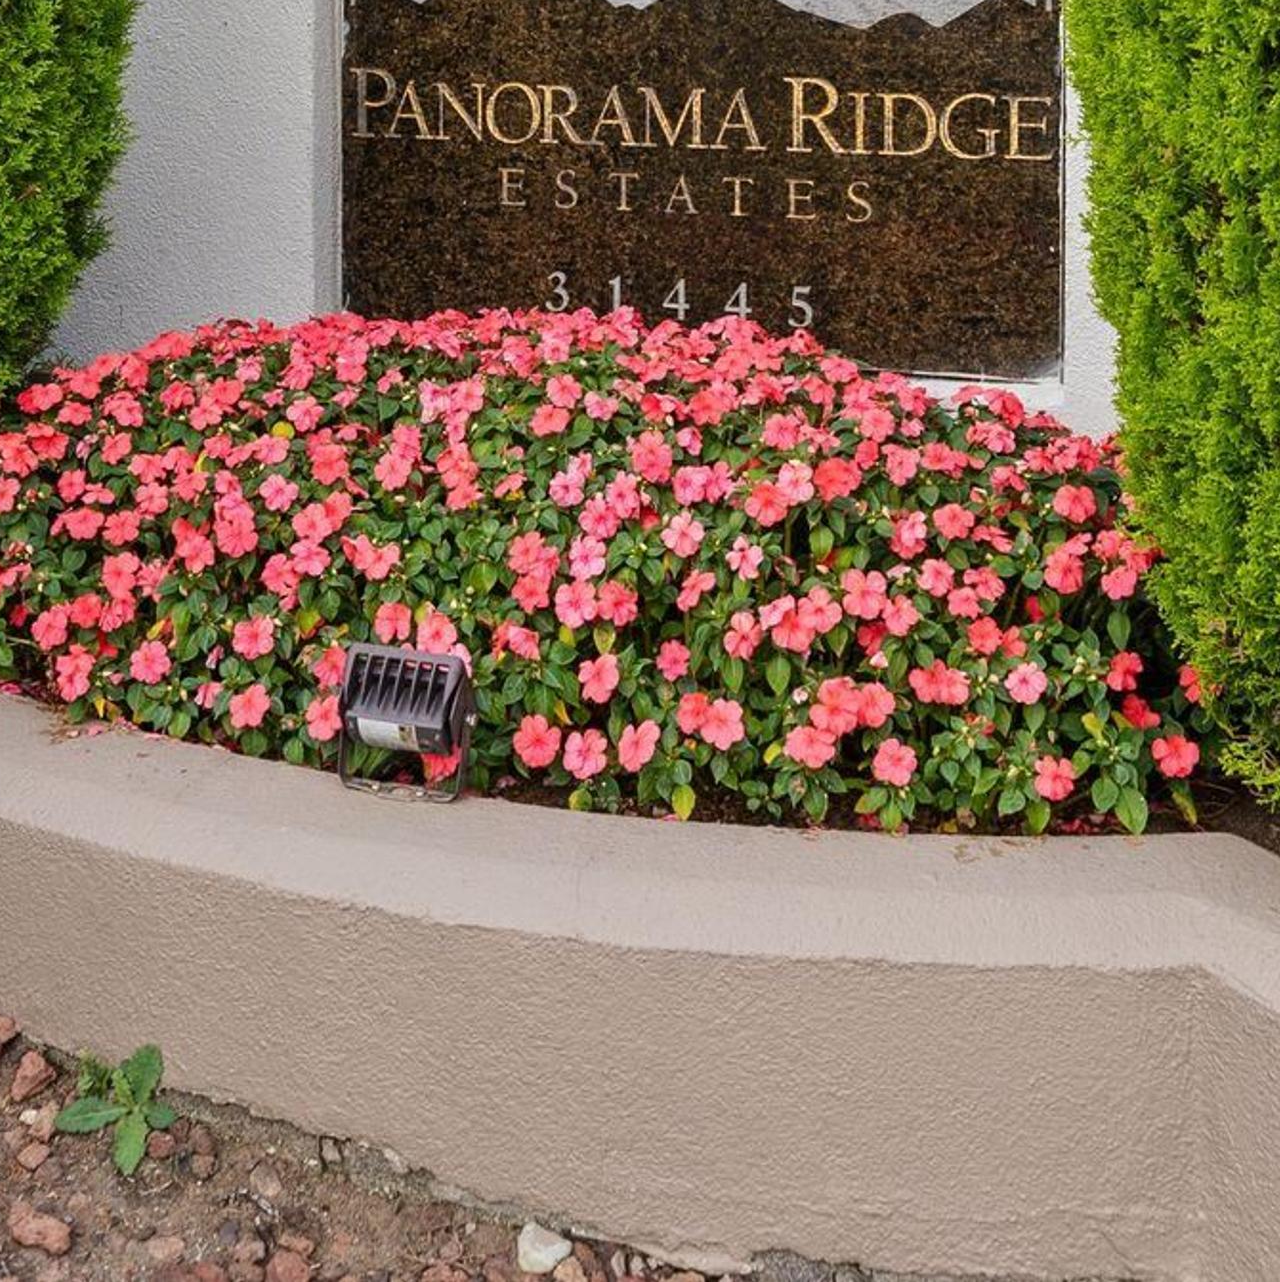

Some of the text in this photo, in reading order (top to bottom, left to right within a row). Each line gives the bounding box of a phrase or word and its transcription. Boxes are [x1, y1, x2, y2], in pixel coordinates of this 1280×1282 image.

[349, 68, 1053, 161] PANORAMA RIDGE
[500, 168, 873, 223] ESTATES
[545, 271, 814, 328] 31445
